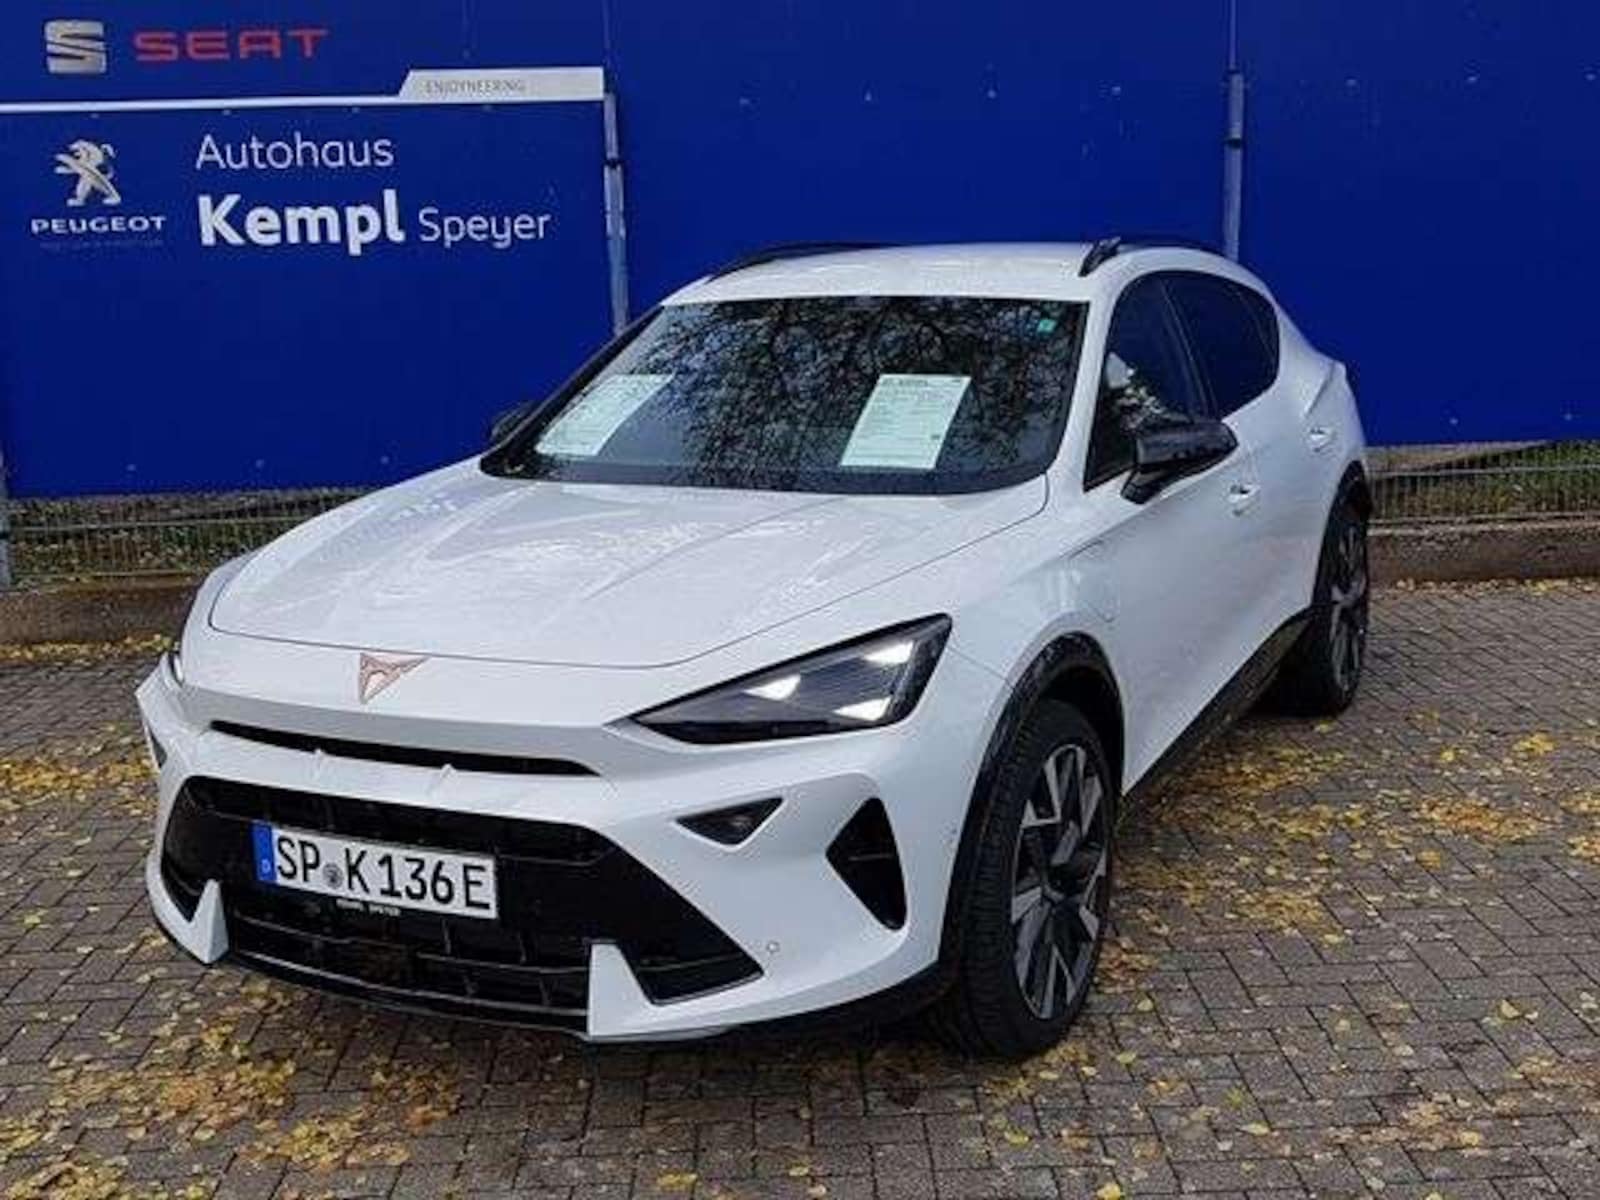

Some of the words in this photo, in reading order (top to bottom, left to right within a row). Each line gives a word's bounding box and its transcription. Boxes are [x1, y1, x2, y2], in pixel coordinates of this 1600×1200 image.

[133, 28, 327, 62] SEAT
[195, 132, 394, 170] Autohaus
[31, 215, 166, 235] PEUGEOT
[198, 188, 405, 256] Kempl
[417, 207, 551, 249] Speyer
[277, 835, 321, 883] SP
